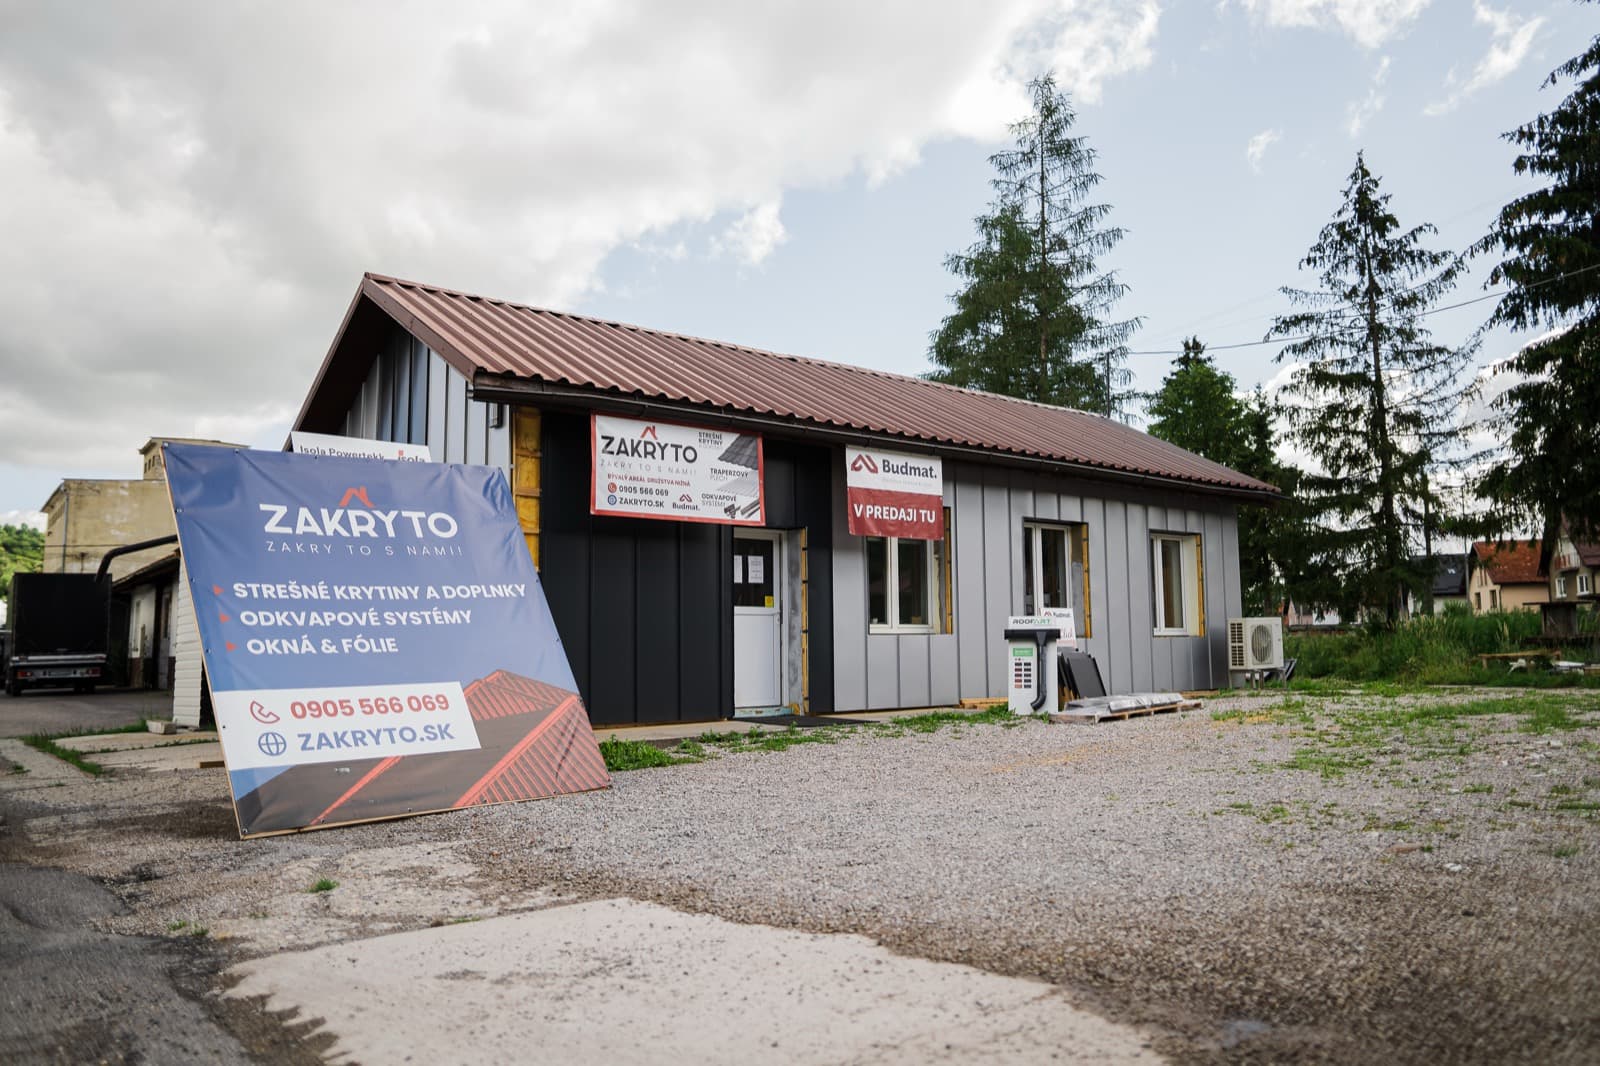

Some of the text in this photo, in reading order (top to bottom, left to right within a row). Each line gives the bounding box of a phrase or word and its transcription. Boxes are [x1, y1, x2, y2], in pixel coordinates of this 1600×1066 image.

[299, 445, 326, 455] Isola
[328, 448, 385, 460] Powertekk
[600, 435, 698, 464] ZAKRYTO
[882, 459, 938, 479] Budmat.
[619, 485, 669, 497] 0905 566 069
[619, 497, 665, 508] ZAKRYTO.SK
[259, 503, 458, 539] ZAKRYTO
[853, 503, 936, 524] V PREDAJI TU
[265, 541, 333, 555] ZAKRY
[346, 545, 371, 556] TO
[385, 545, 394, 557] S
[233, 580, 527, 600] STREŠNÉ KRYTINY A DOPLNKY
[240, 606, 472, 627] ODKVAPOVÉ SYSTÉMY
[246, 633, 399, 655] OKNÁ & FÓLIE
[290, 694, 450, 720] 0905 566 069
[297, 723, 456, 752] ZAKRYTO.SK
